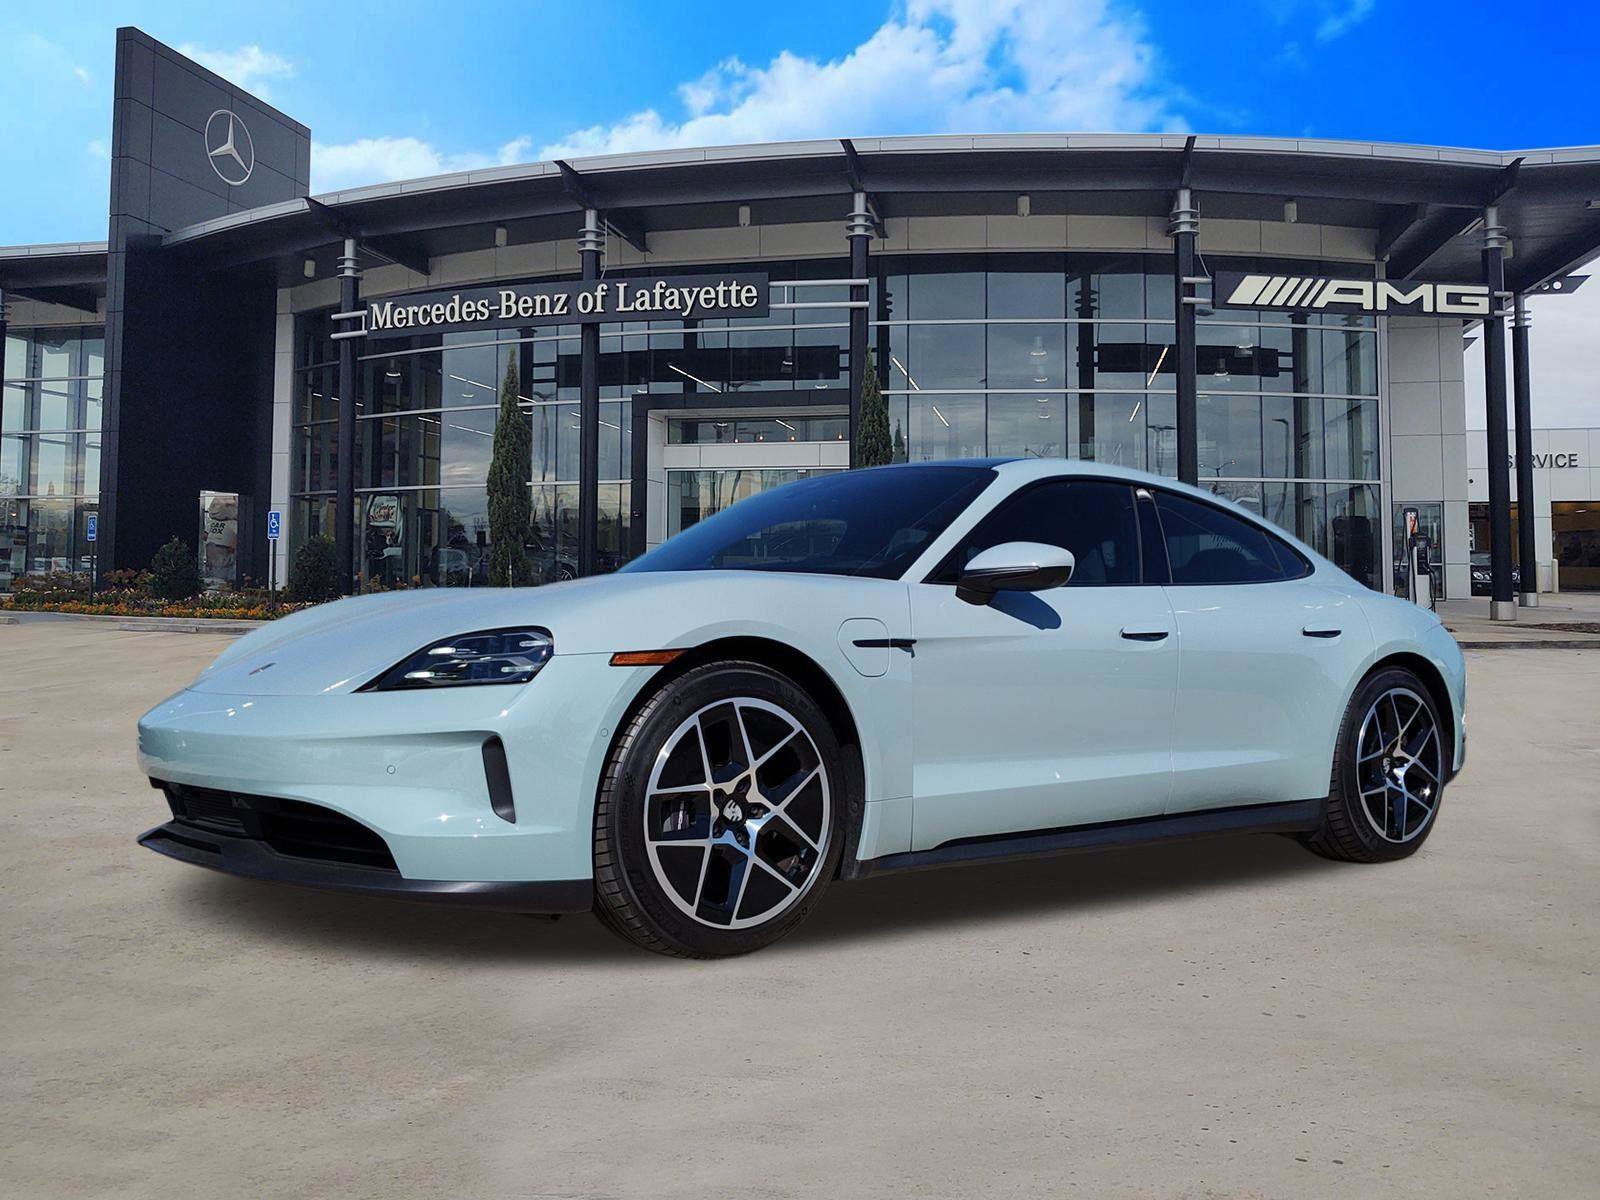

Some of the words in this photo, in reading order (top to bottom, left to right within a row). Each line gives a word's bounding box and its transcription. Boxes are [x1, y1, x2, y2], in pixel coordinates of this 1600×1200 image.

[370, 289, 568, 330] Mercedes-Benz
[577, 283, 607, 314] of
[615, 279, 758, 317] Lafayette
[1312, 279, 1490, 315] AMG
